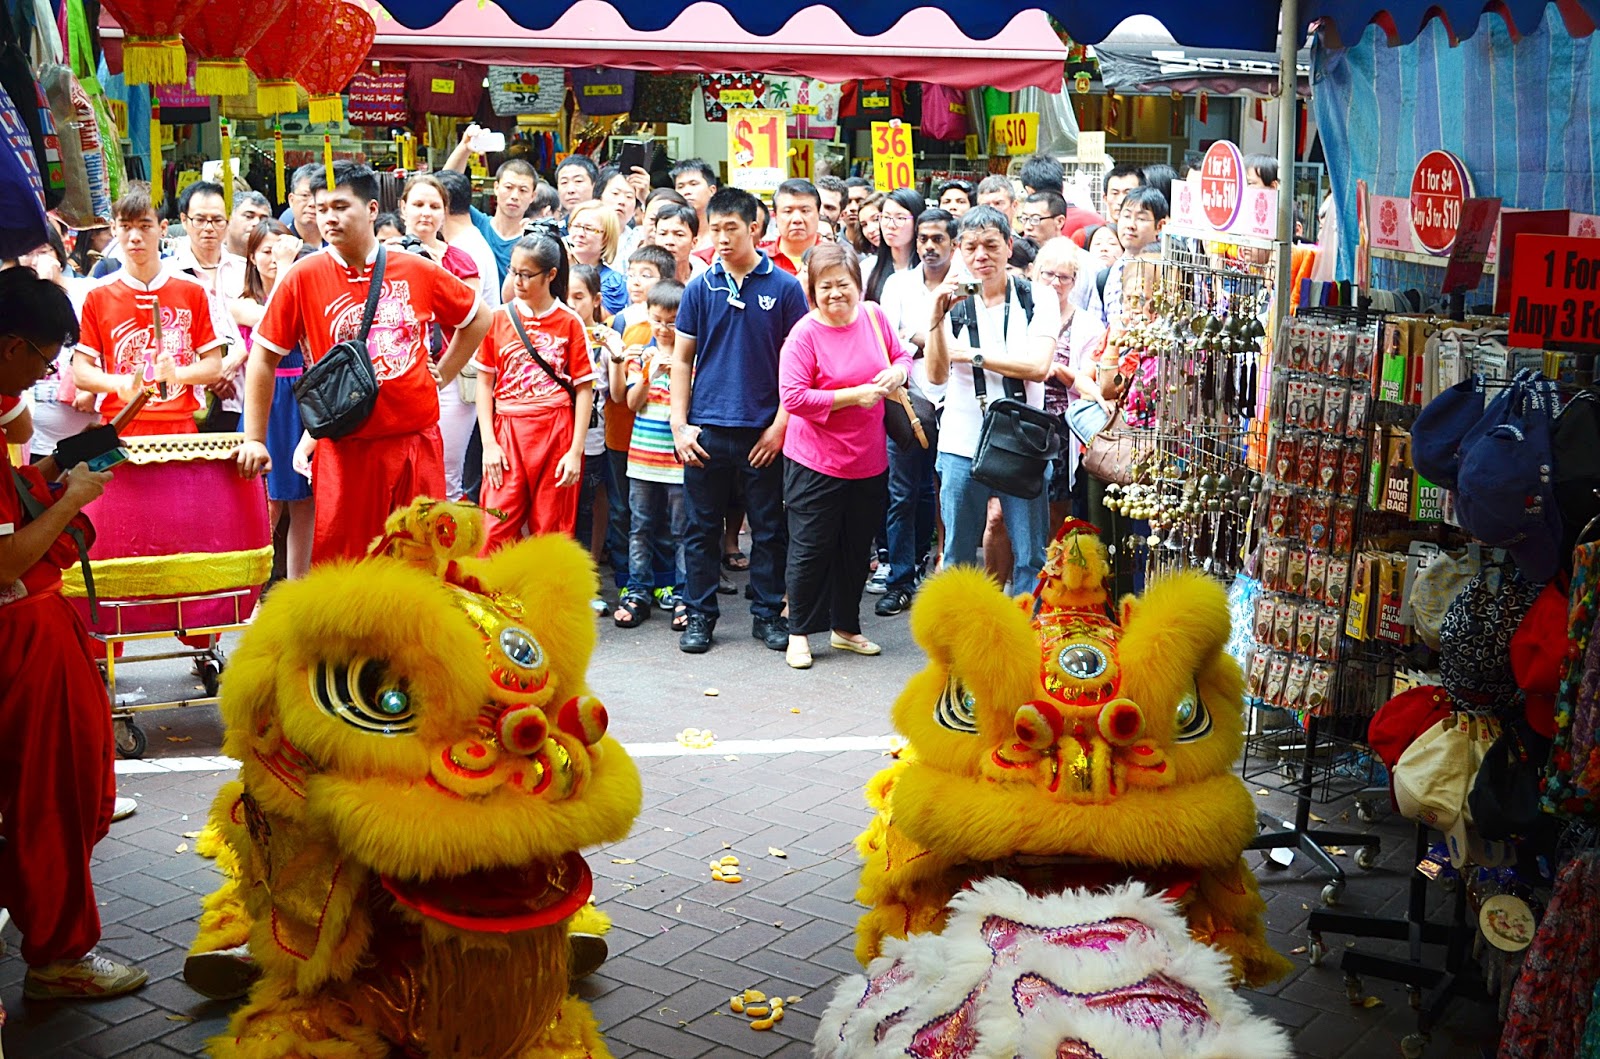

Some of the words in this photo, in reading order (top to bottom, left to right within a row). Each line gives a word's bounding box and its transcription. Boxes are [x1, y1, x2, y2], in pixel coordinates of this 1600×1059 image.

[876, 126, 907, 157] 36
[1006, 119, 1027, 147] $10
[735, 117, 778, 168] $1
[1213, 156, 1222, 177] for
[1420, 168, 1425, 190] 1
[1427, 168, 1440, 191] for
[1441, 169, 1453, 194] $4
[1211, 181, 1217, 208] 3
[1413, 206, 1426, 231] Any
[1426, 197, 1433, 227] 3
[1433, 208, 1442, 229] for
[1443, 198, 1460, 233] $10
[1544, 250, 1555, 287] 1
[1513, 296, 1558, 339] Any
[1561, 299, 1577, 337] 3
[1381, 380, 1400, 391] HANDS
[1388, 477, 1409, 492] not
[1420, 486, 1439, 499] no
[1388, 489, 1408, 502] YOUR
[1420, 498, 1437, 509] YOU
[1386, 499, 1407, 513] BAG!
[1419, 508, 1444, 519] BAG!
[1382, 604, 1397, 614] PUT
[1379, 628, 1400, 640] MINE!
